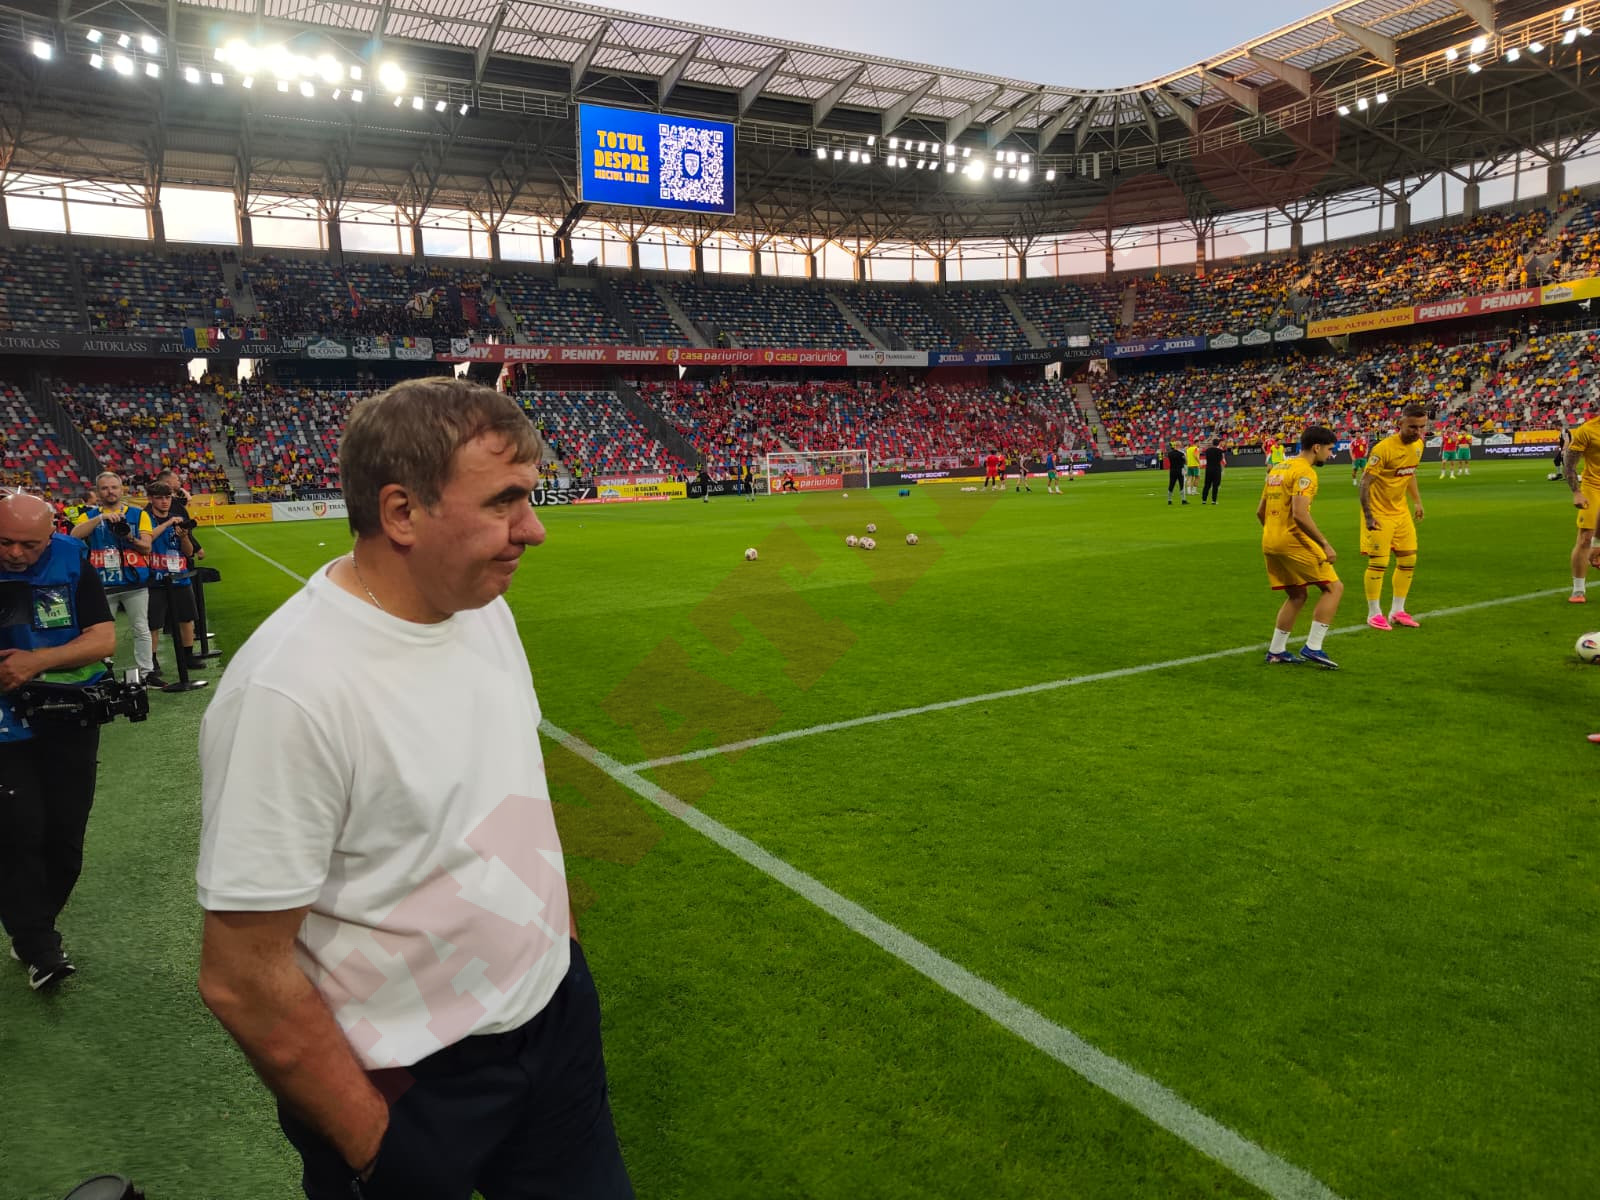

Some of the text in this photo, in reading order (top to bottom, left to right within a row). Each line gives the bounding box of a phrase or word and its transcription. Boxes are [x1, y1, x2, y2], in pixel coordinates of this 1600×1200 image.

[597, 129, 645, 152] TOTUL
[594, 149, 649, 171] DESPRE
[82, 341, 148, 352] AUTOKLASS
[681, 352, 702, 361] casa
[775, 351, 841, 363] casa pariurilor
[99, 570, 123, 583] 121
